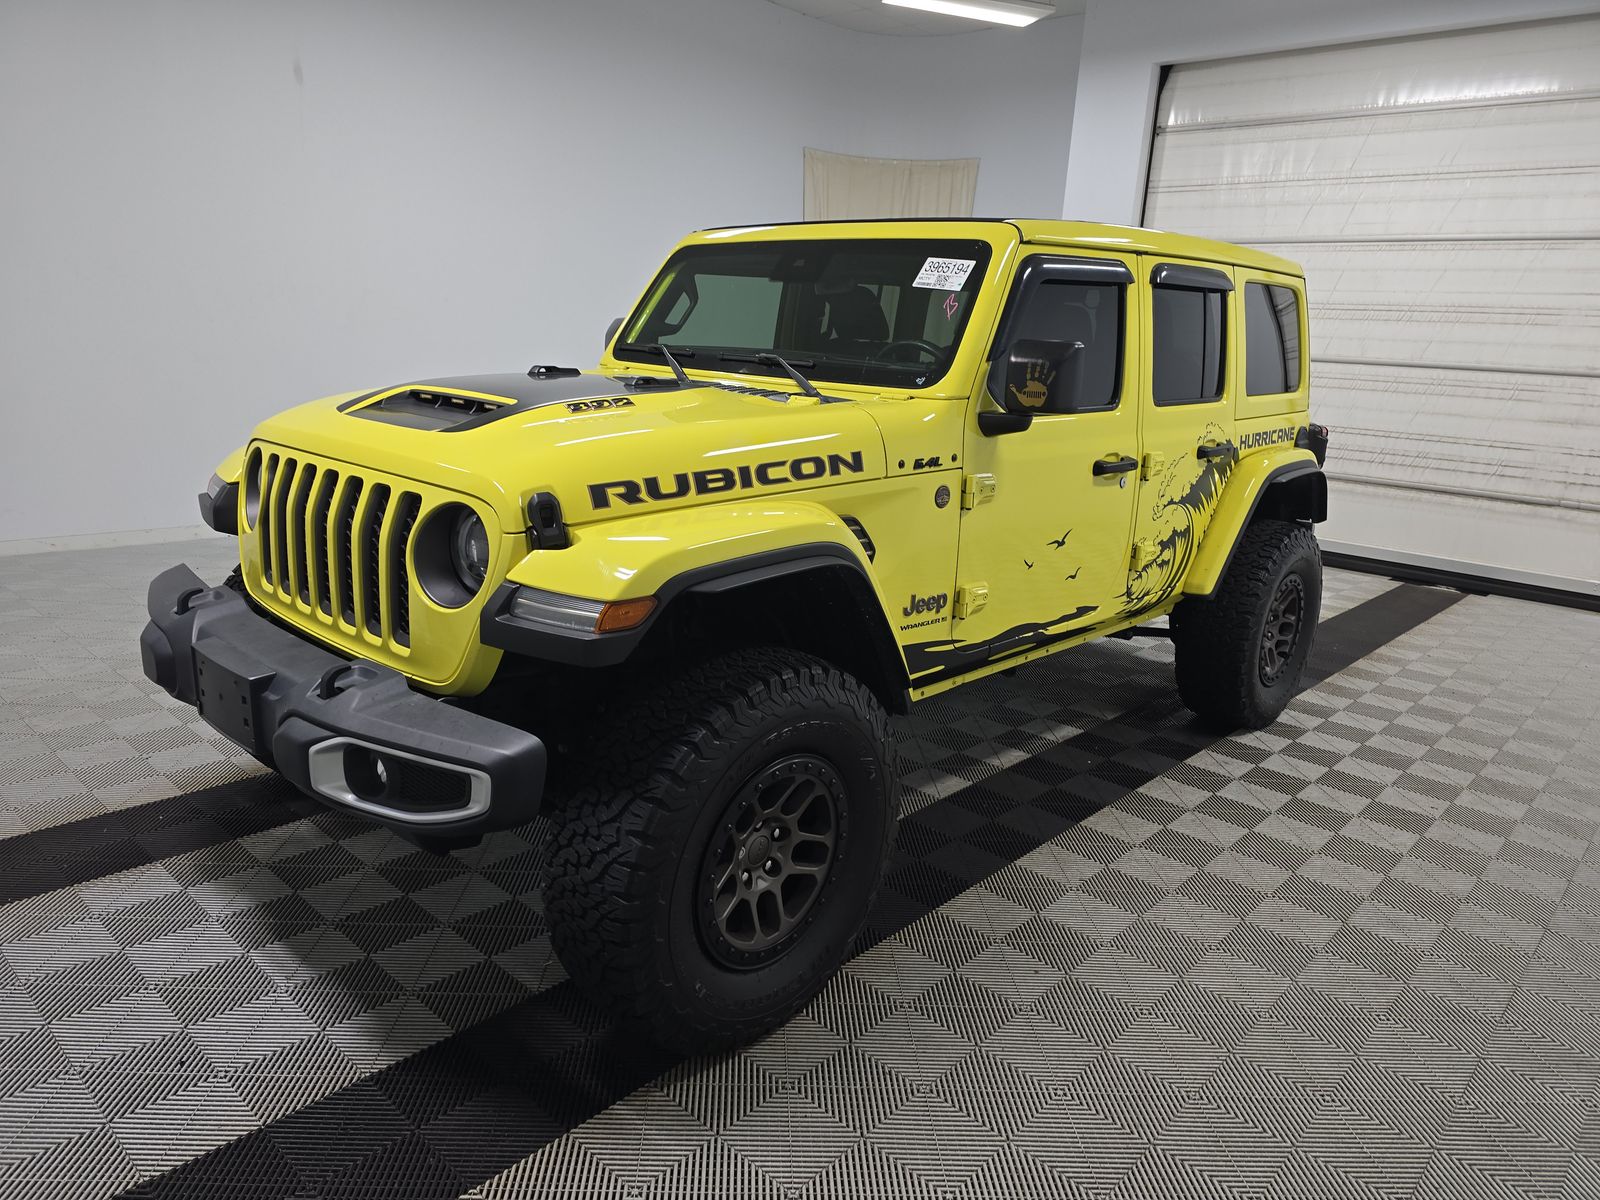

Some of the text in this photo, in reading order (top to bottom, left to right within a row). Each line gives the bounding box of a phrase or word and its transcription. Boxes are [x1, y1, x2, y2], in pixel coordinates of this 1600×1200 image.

[924, 261, 970, 275] 3965194
[1240, 427, 1295, 450] HURRICANE
[587, 451, 864, 510] RUBICON
[902, 592, 948, 617] Jeep
[900, 619, 940, 632] WRANGLER
